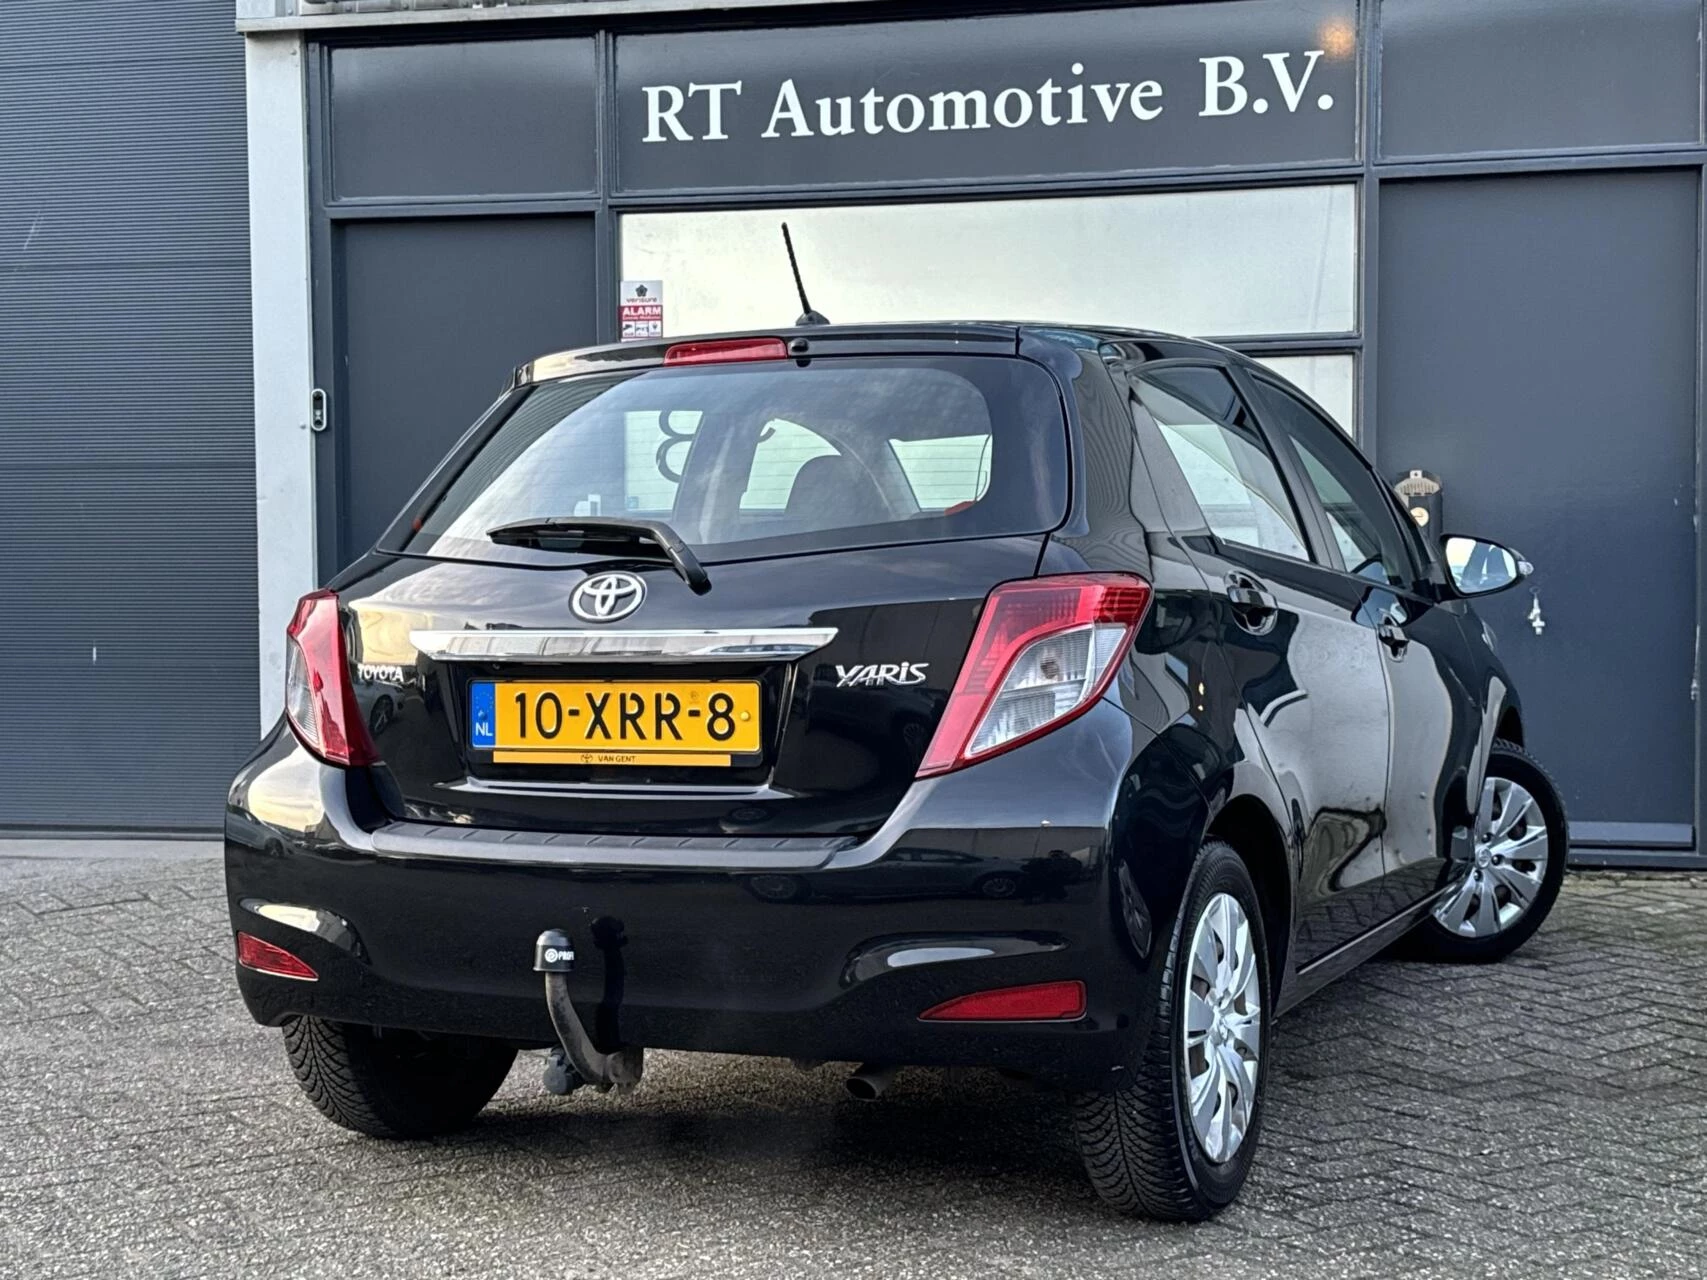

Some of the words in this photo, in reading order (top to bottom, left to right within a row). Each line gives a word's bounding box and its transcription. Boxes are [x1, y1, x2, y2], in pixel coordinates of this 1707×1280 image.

[641, 79, 743, 143] RT
[760, 62, 1164, 139] Automotive
[1198, 50, 1335, 117] B.V.
[622, 306, 662, 316] ALARM
[357, 663, 404, 682] TOYOTA
[515, 692, 736, 741] 10-XRR-8
[475, 722, 493, 737] NL
[598, 754, 614, 762] VAN
[615, 755, 636, 763] GENT
